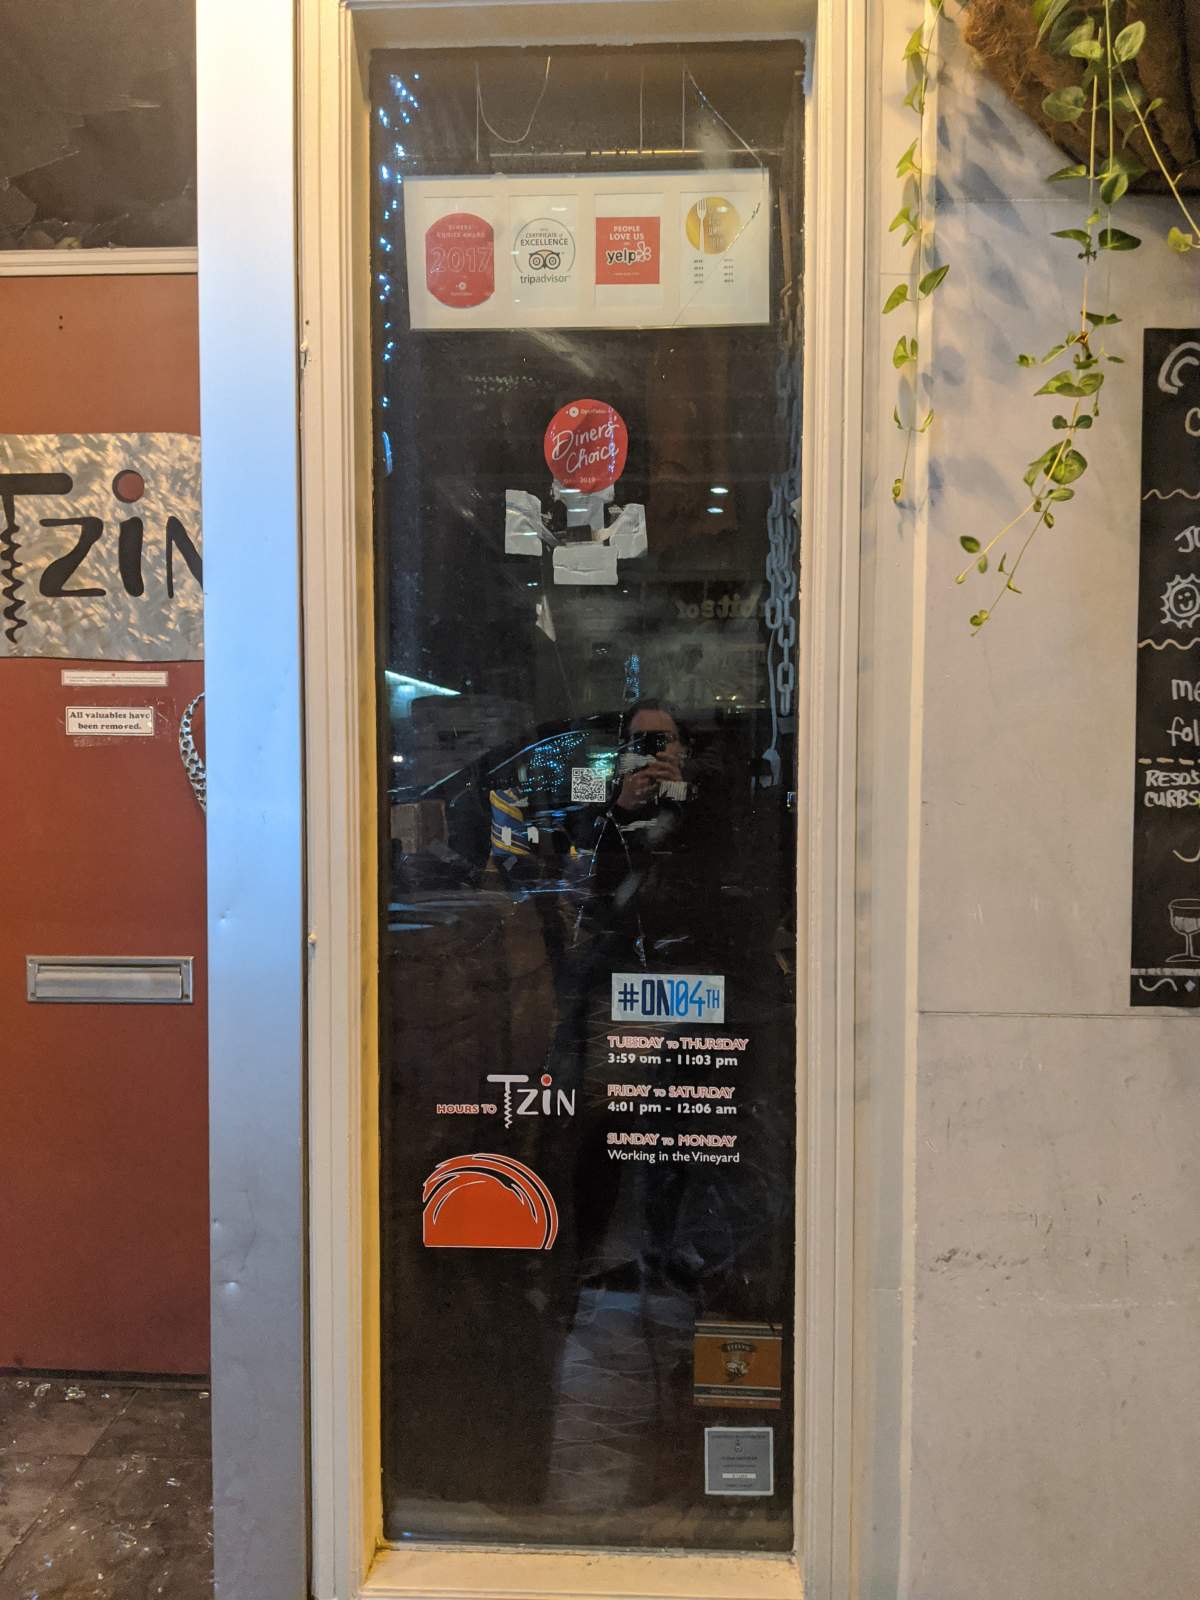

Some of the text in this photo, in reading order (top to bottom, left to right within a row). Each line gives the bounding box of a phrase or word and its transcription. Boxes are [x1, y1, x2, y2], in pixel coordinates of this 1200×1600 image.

[429, 247, 491, 272] 2017
[606, 248, 637, 265] yelp
[520, 274, 567, 284] tripadvisor
[607, 1035, 749, 1051] TUESDAY TO THURSDAY
[607, 1052, 636, 1064] 3:59
[677, 1054, 711, 1066] 11:03
[715, 1057, 738, 1069] pm
[607, 1084, 736, 1099] FRIDAY TO SATURDAY
[436, 1104, 480, 1115] HOURS
[480, 1104, 498, 1115] TO
[607, 1101, 634, 1112] 4:01
[639, 1103, 662, 1115] pm
[677, 1103, 711, 1114] 12:06
[715, 1105, 737, 1115] am
[606, 1132, 738, 1148] SUNDAY TO MONDAY
[607, 1149, 740, 1165] Working in the Vineyard
